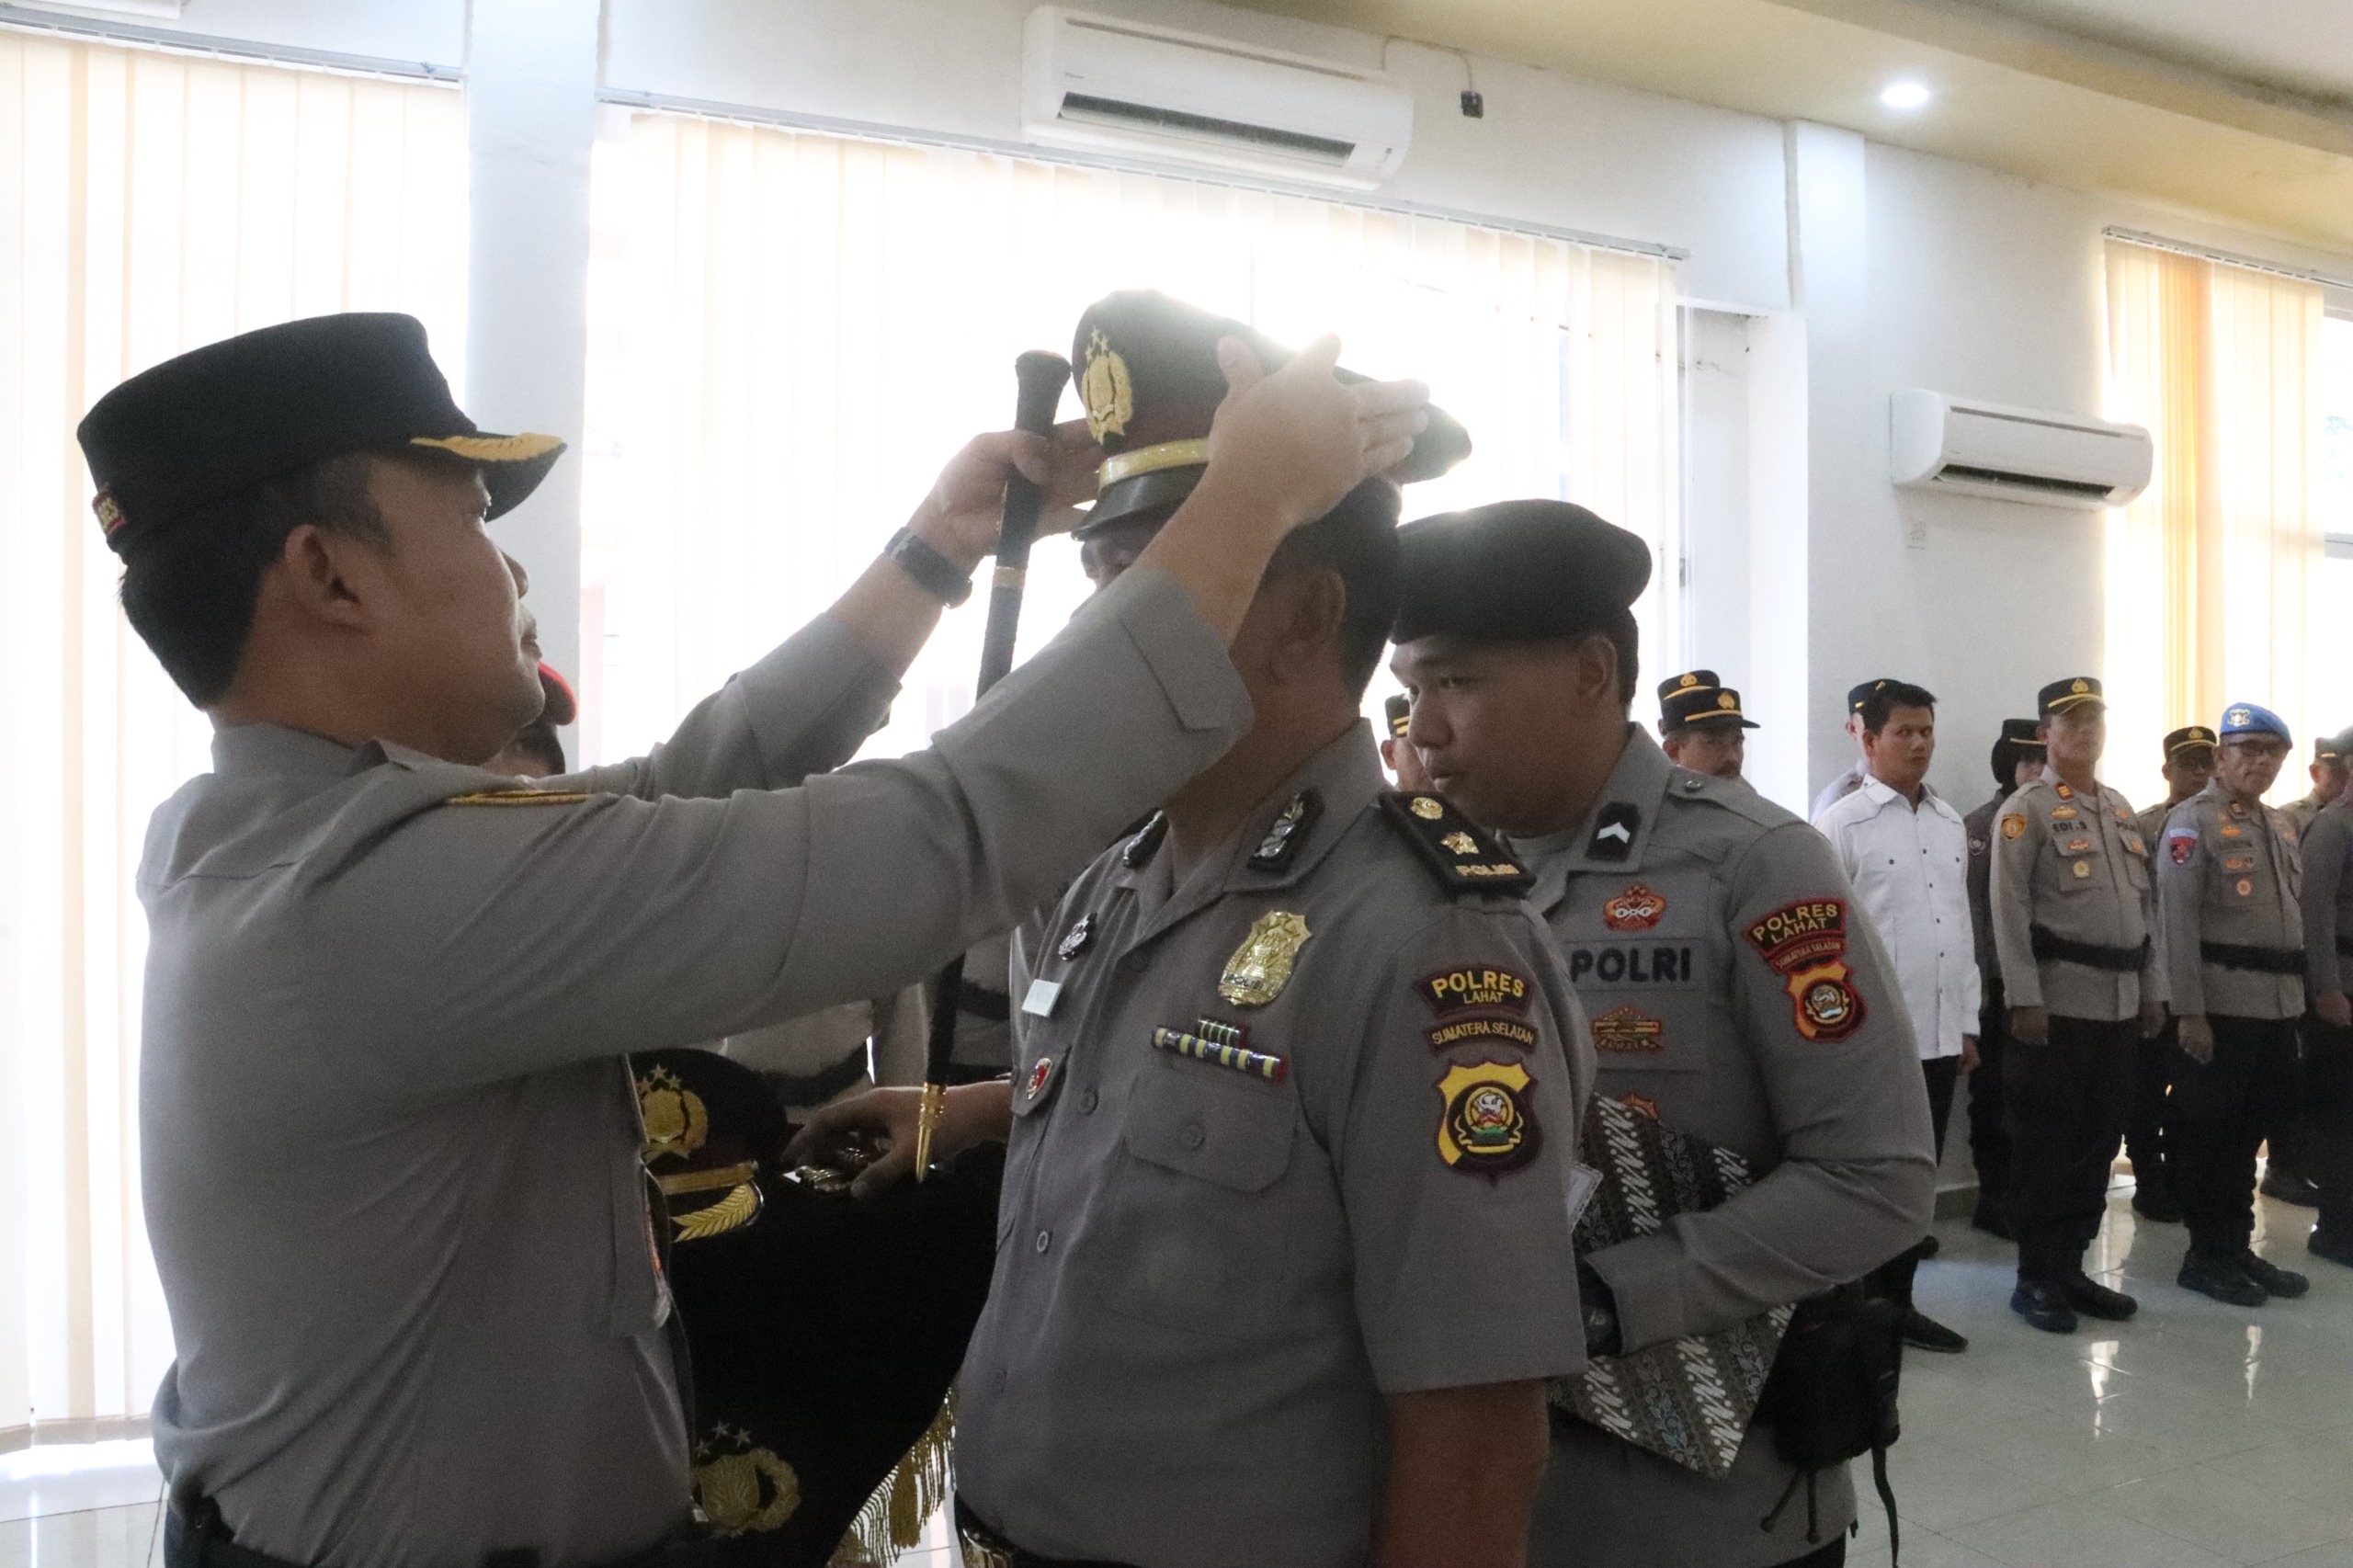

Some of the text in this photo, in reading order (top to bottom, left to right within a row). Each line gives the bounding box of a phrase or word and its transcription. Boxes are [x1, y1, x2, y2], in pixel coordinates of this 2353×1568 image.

[1753, 904, 1837, 941] POLRES
[1771, 917, 1827, 944] LAHAT
[1570, 948, 1690, 983] POLRI
[1432, 971, 1524, 998] POLRES
[1463, 991, 1505, 1004] LAHAT
[1432, 1021, 1534, 1044] SUMATERA SELATAN
